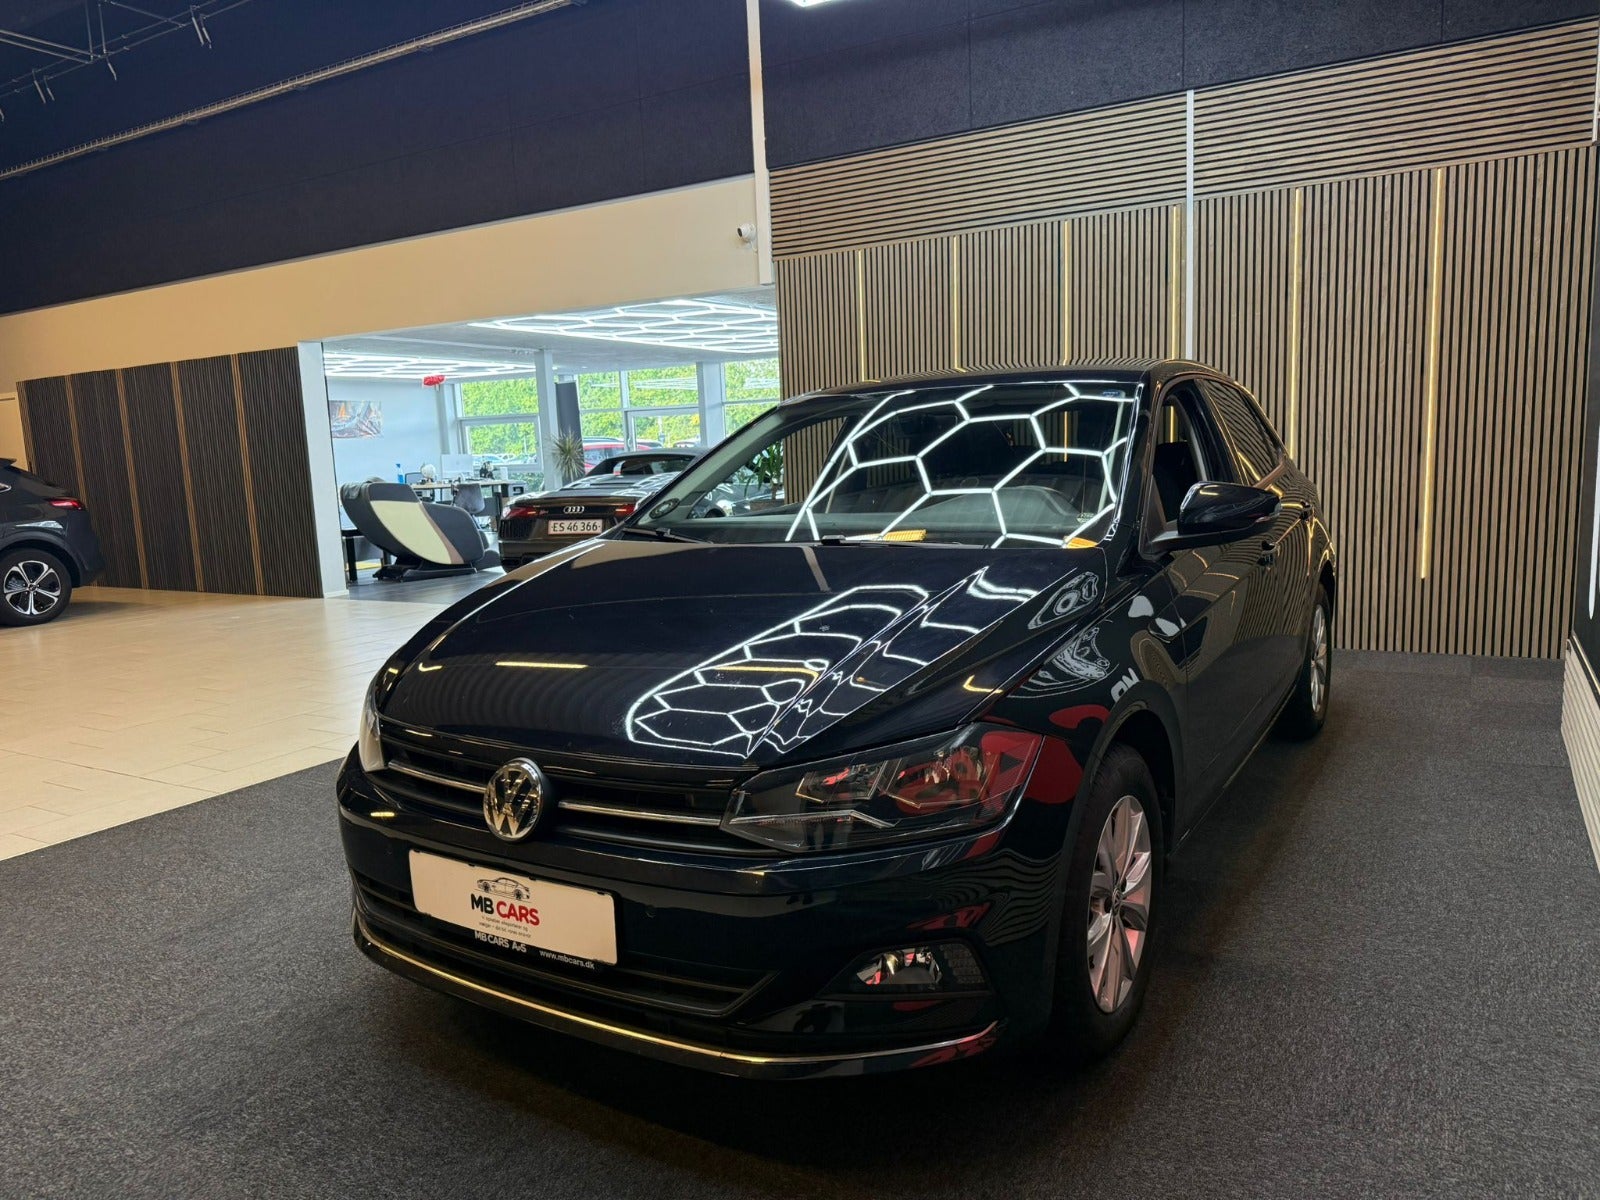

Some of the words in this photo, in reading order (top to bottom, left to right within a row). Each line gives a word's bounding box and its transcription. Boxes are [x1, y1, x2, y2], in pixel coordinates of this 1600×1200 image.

[552, 522, 565, 532] ES
[567, 521, 578, 532] 46
[580, 521, 598, 532] 366
[470, 893, 494, 915] MB
[496, 900, 540, 926] CARS
[487, 934, 510, 949] CARS
[539, 950, 595, 970] www.mbcars.dk
